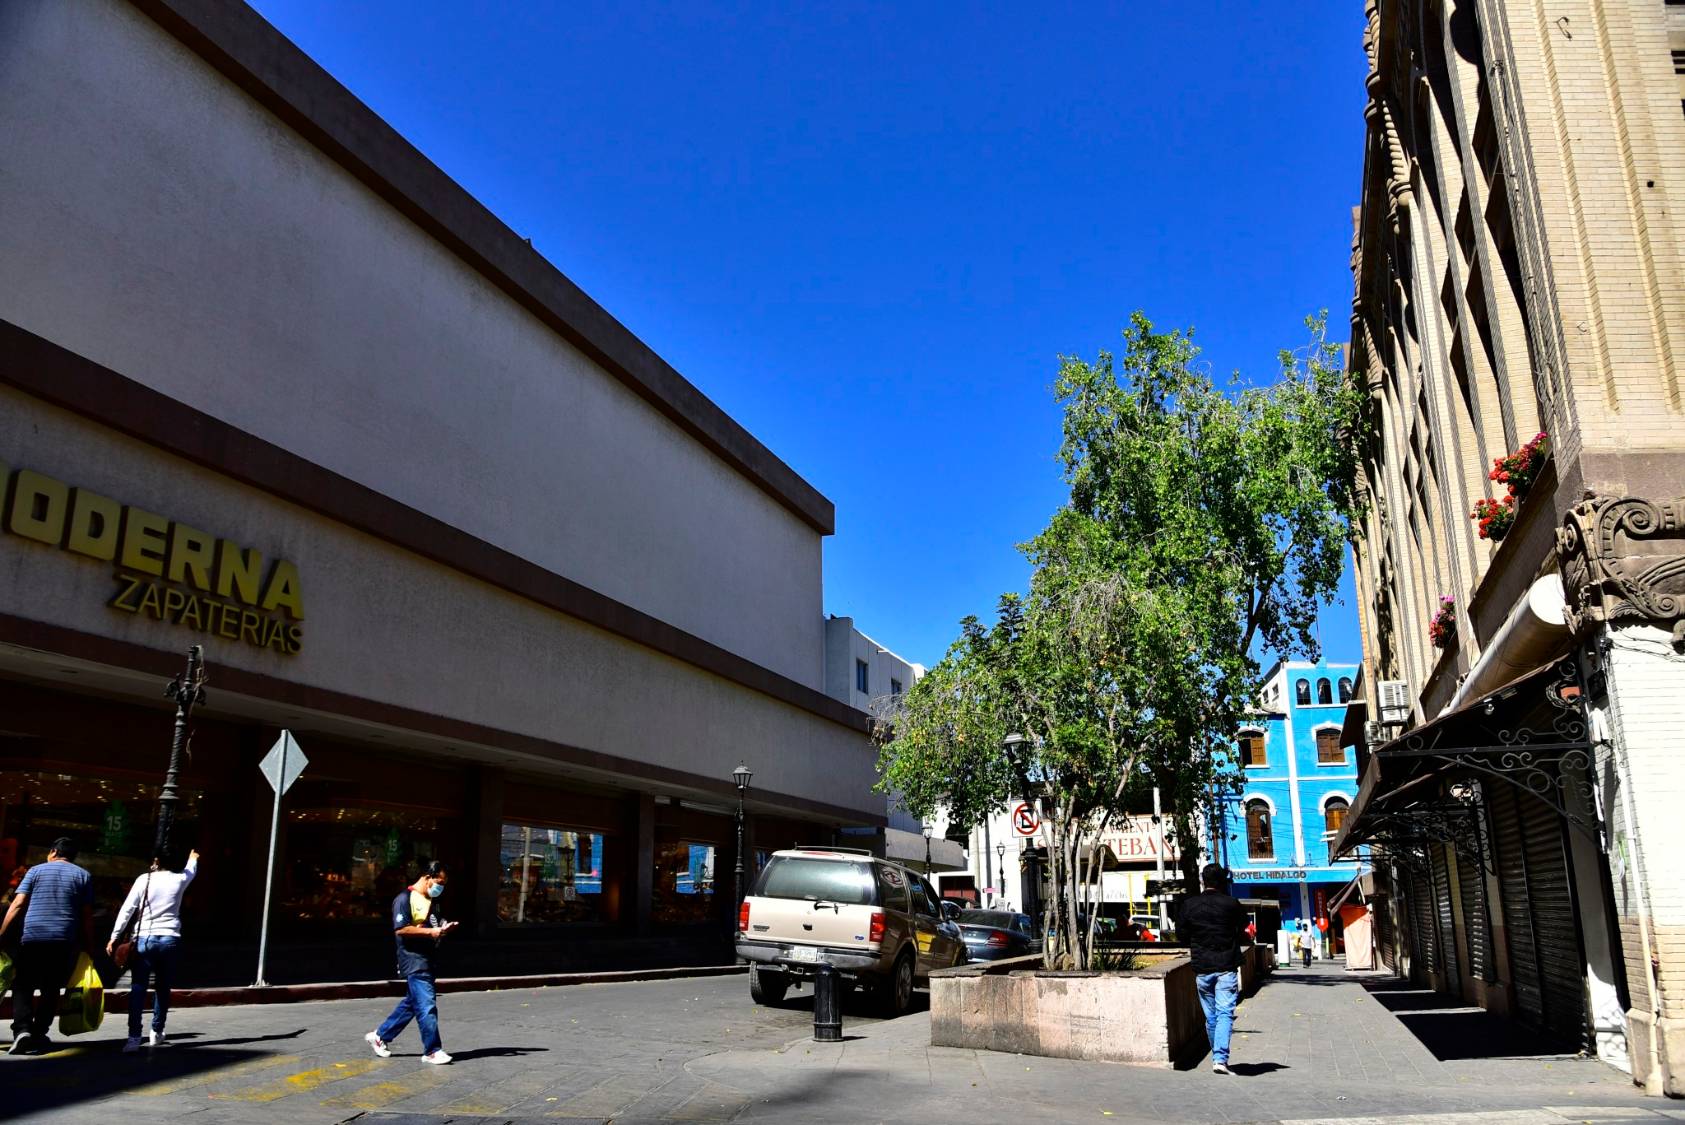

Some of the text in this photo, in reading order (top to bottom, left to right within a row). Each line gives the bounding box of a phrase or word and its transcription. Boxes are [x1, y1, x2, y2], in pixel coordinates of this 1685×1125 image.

[0, 460, 304, 621] ODERNA
[113, 573, 303, 656] ZAPATERIAS
[106, 815, 122, 832] 15
[1233, 870, 1307, 880] HOTEL HIDALGO
